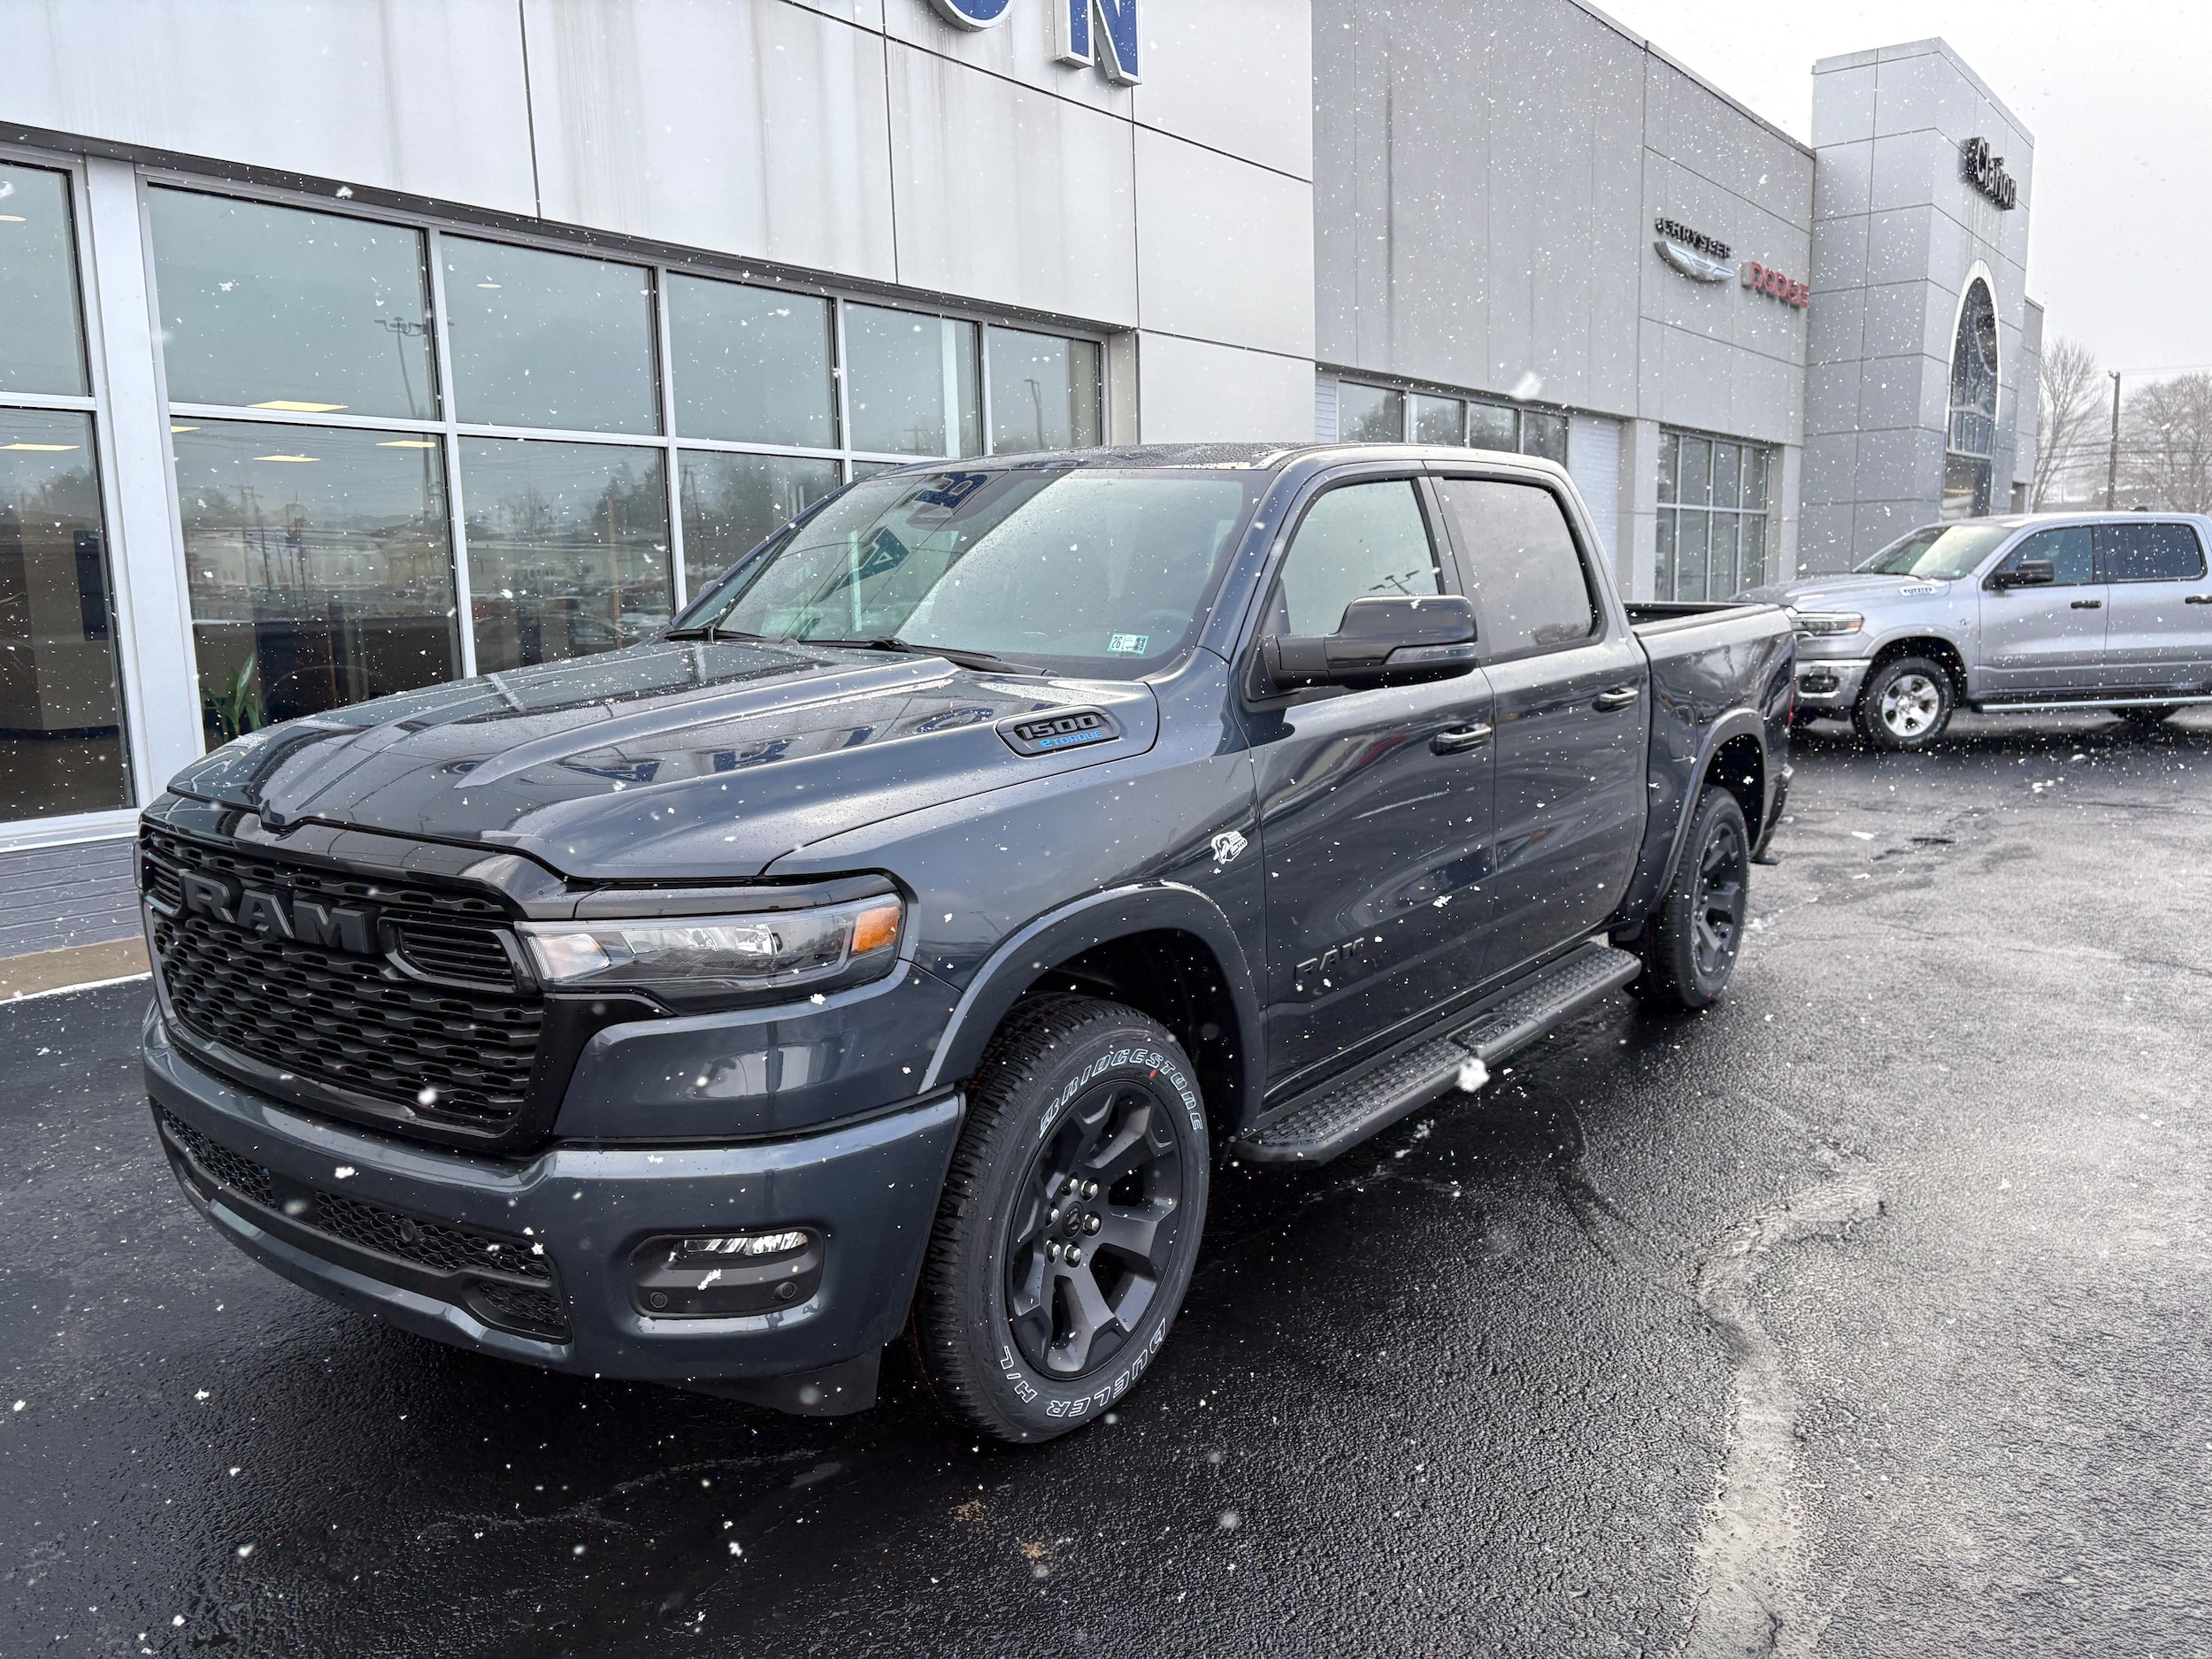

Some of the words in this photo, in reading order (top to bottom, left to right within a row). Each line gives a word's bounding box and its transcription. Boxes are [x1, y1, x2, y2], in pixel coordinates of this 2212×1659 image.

[1970, 136, 2017, 211] Clarion
[1745, 260, 1811, 310] DODGE
[1014, 713, 1100, 741] 1500
[179, 866, 381, 955] RAM
[1039, 1048, 1203, 1140] BRIDGESTONE
[1046, 1317, 1167, 1417] DUELER
